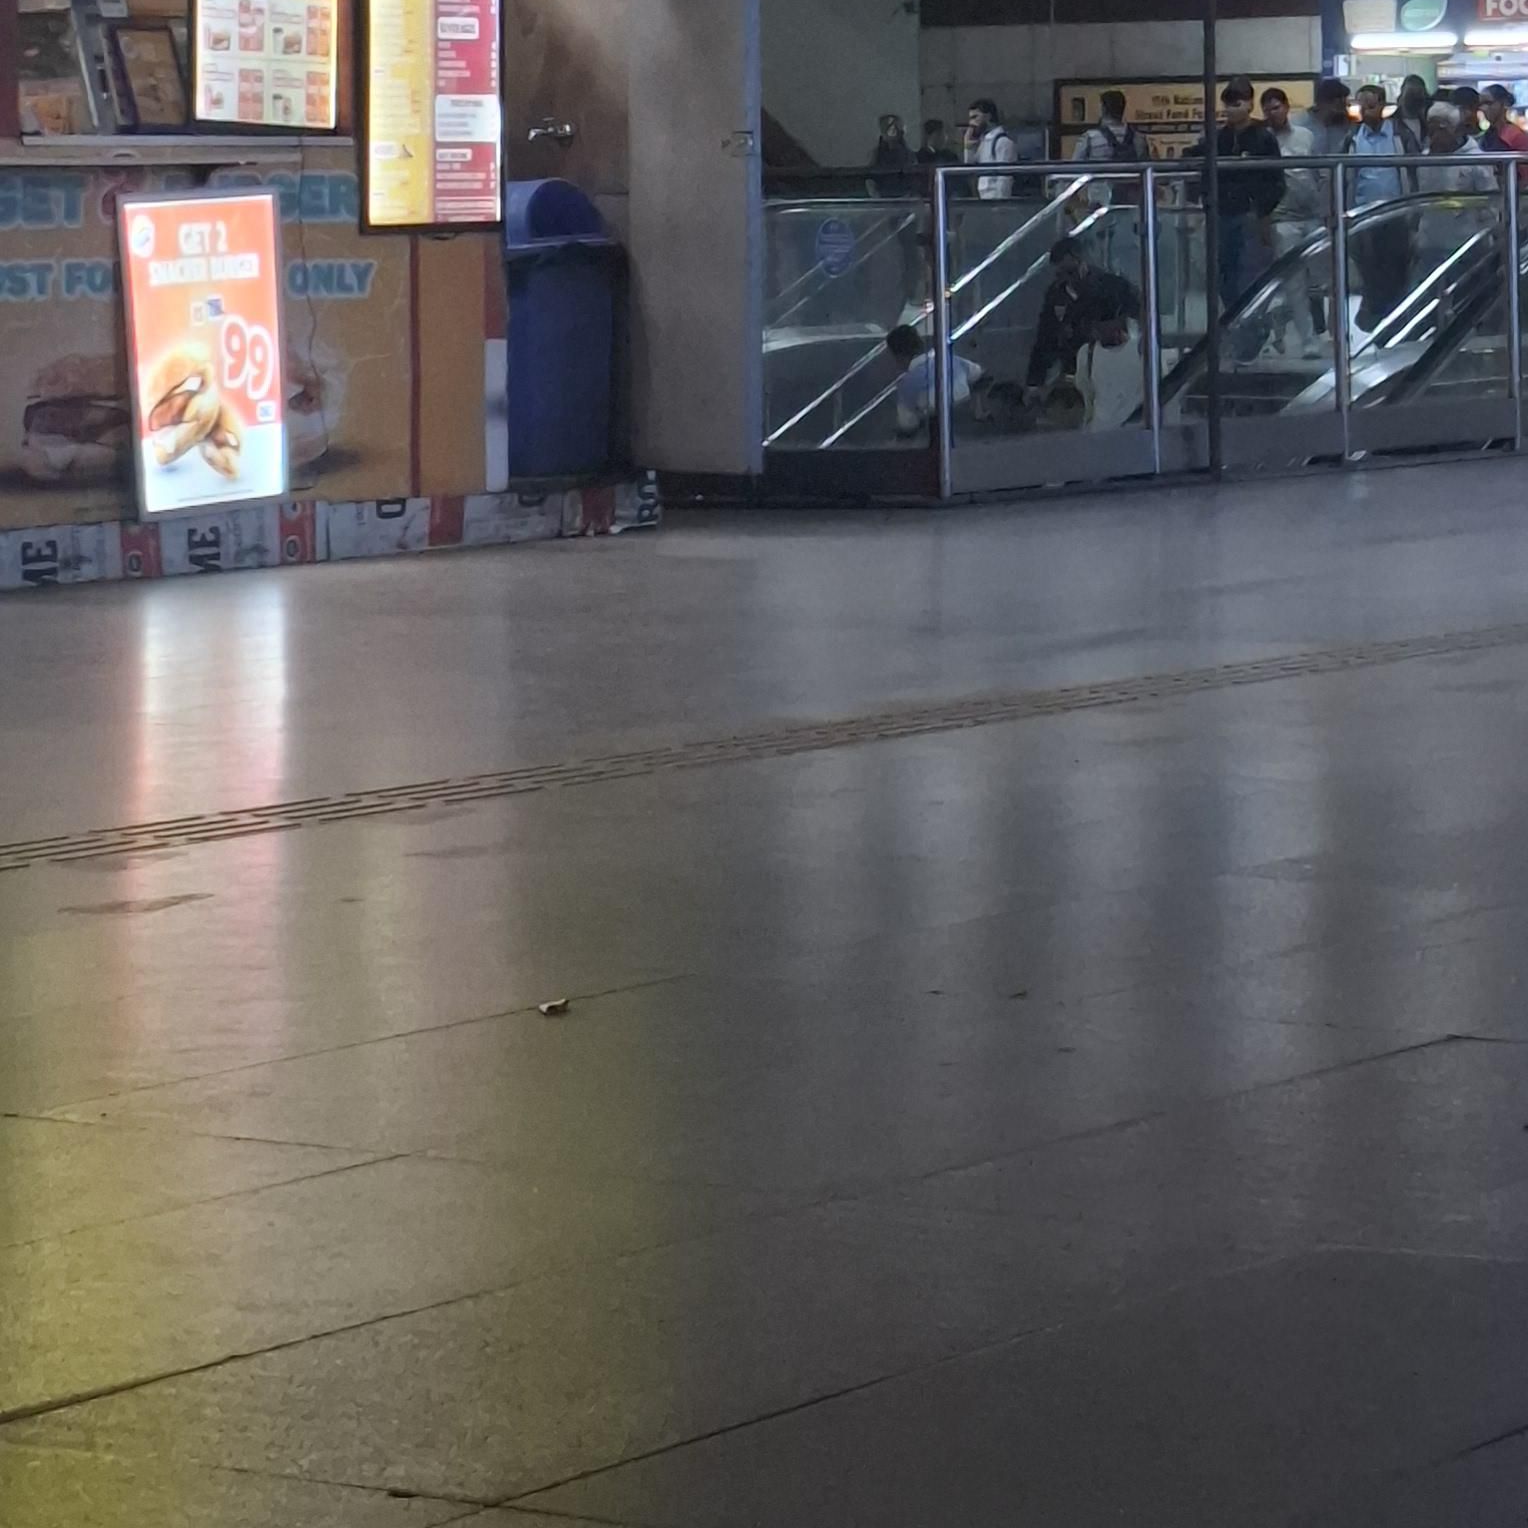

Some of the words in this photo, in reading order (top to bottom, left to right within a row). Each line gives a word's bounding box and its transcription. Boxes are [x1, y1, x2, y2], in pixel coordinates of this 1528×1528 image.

[0, 260, 53, 296] ST
[64, 260, 114, 294] FO
[288, 260, 374, 297] ONLY
[222, 314, 272, 400] 99
